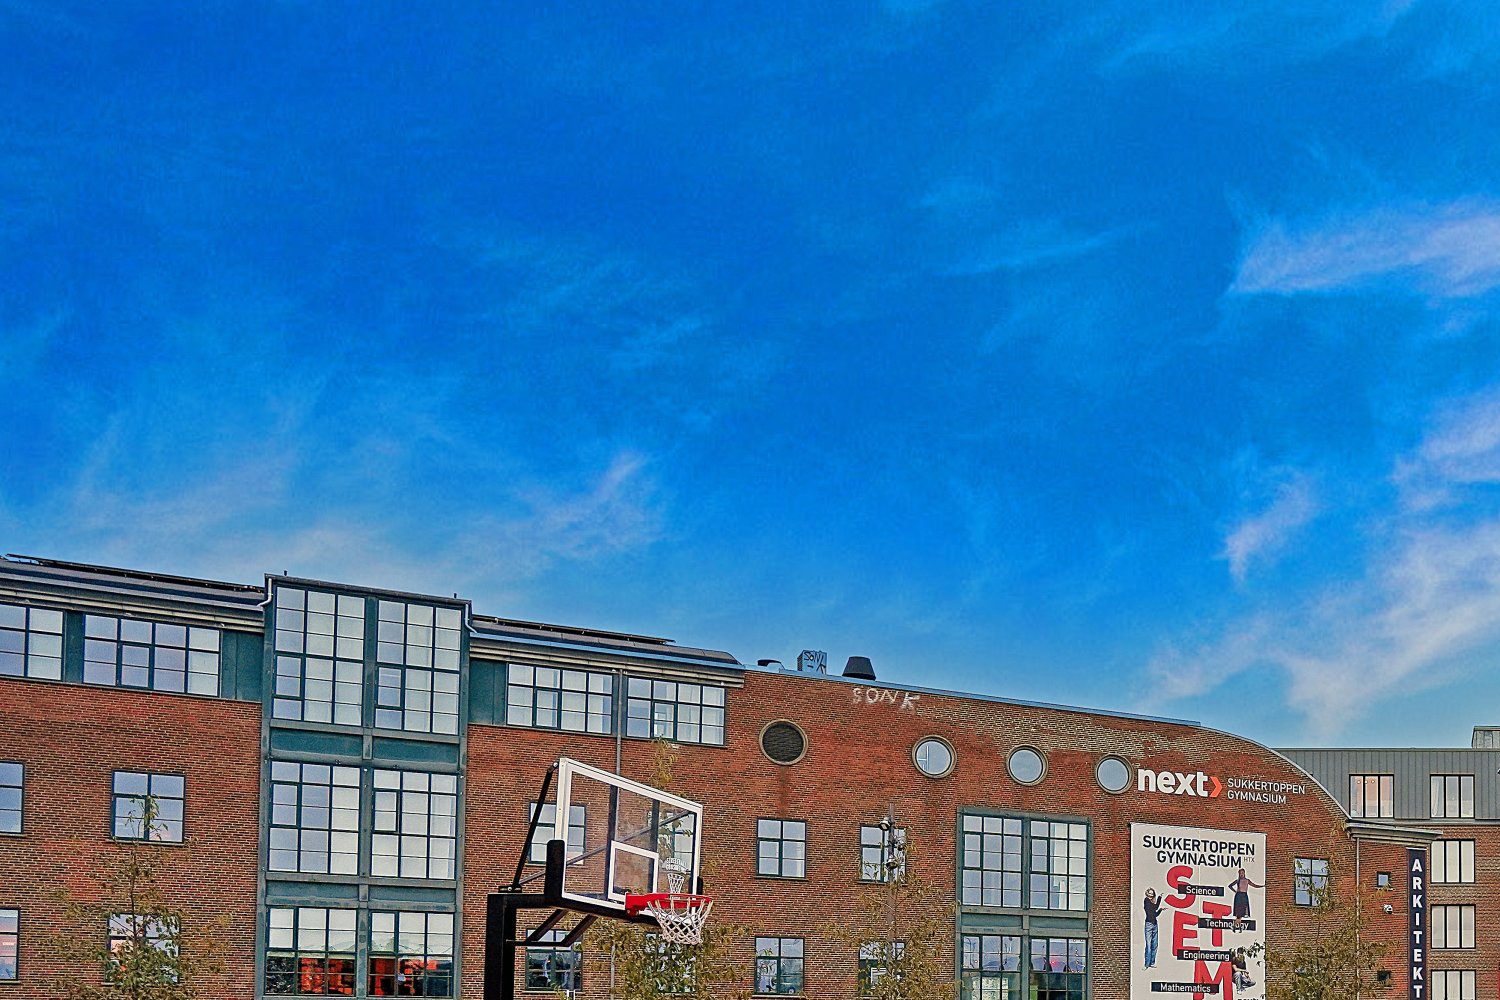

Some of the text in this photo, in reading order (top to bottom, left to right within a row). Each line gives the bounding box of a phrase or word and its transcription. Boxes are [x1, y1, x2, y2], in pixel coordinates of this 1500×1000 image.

[852, 687, 920, 710] SONK
[1137, 768, 1209, 798] next
[1227, 778, 1306, 794] SUKKERTOPPEN
[1227, 789, 1287, 805] GYMNASIUM
[1142, 835, 1256, 856] SUKKERTOPPEN
[1157, 850, 1242, 869] GYMNASIUM
[1186, 886, 1217, 896] Science
[1183, 950, 1230, 962] Engineering
[1160, 982, 1211, 993] Mathematics
